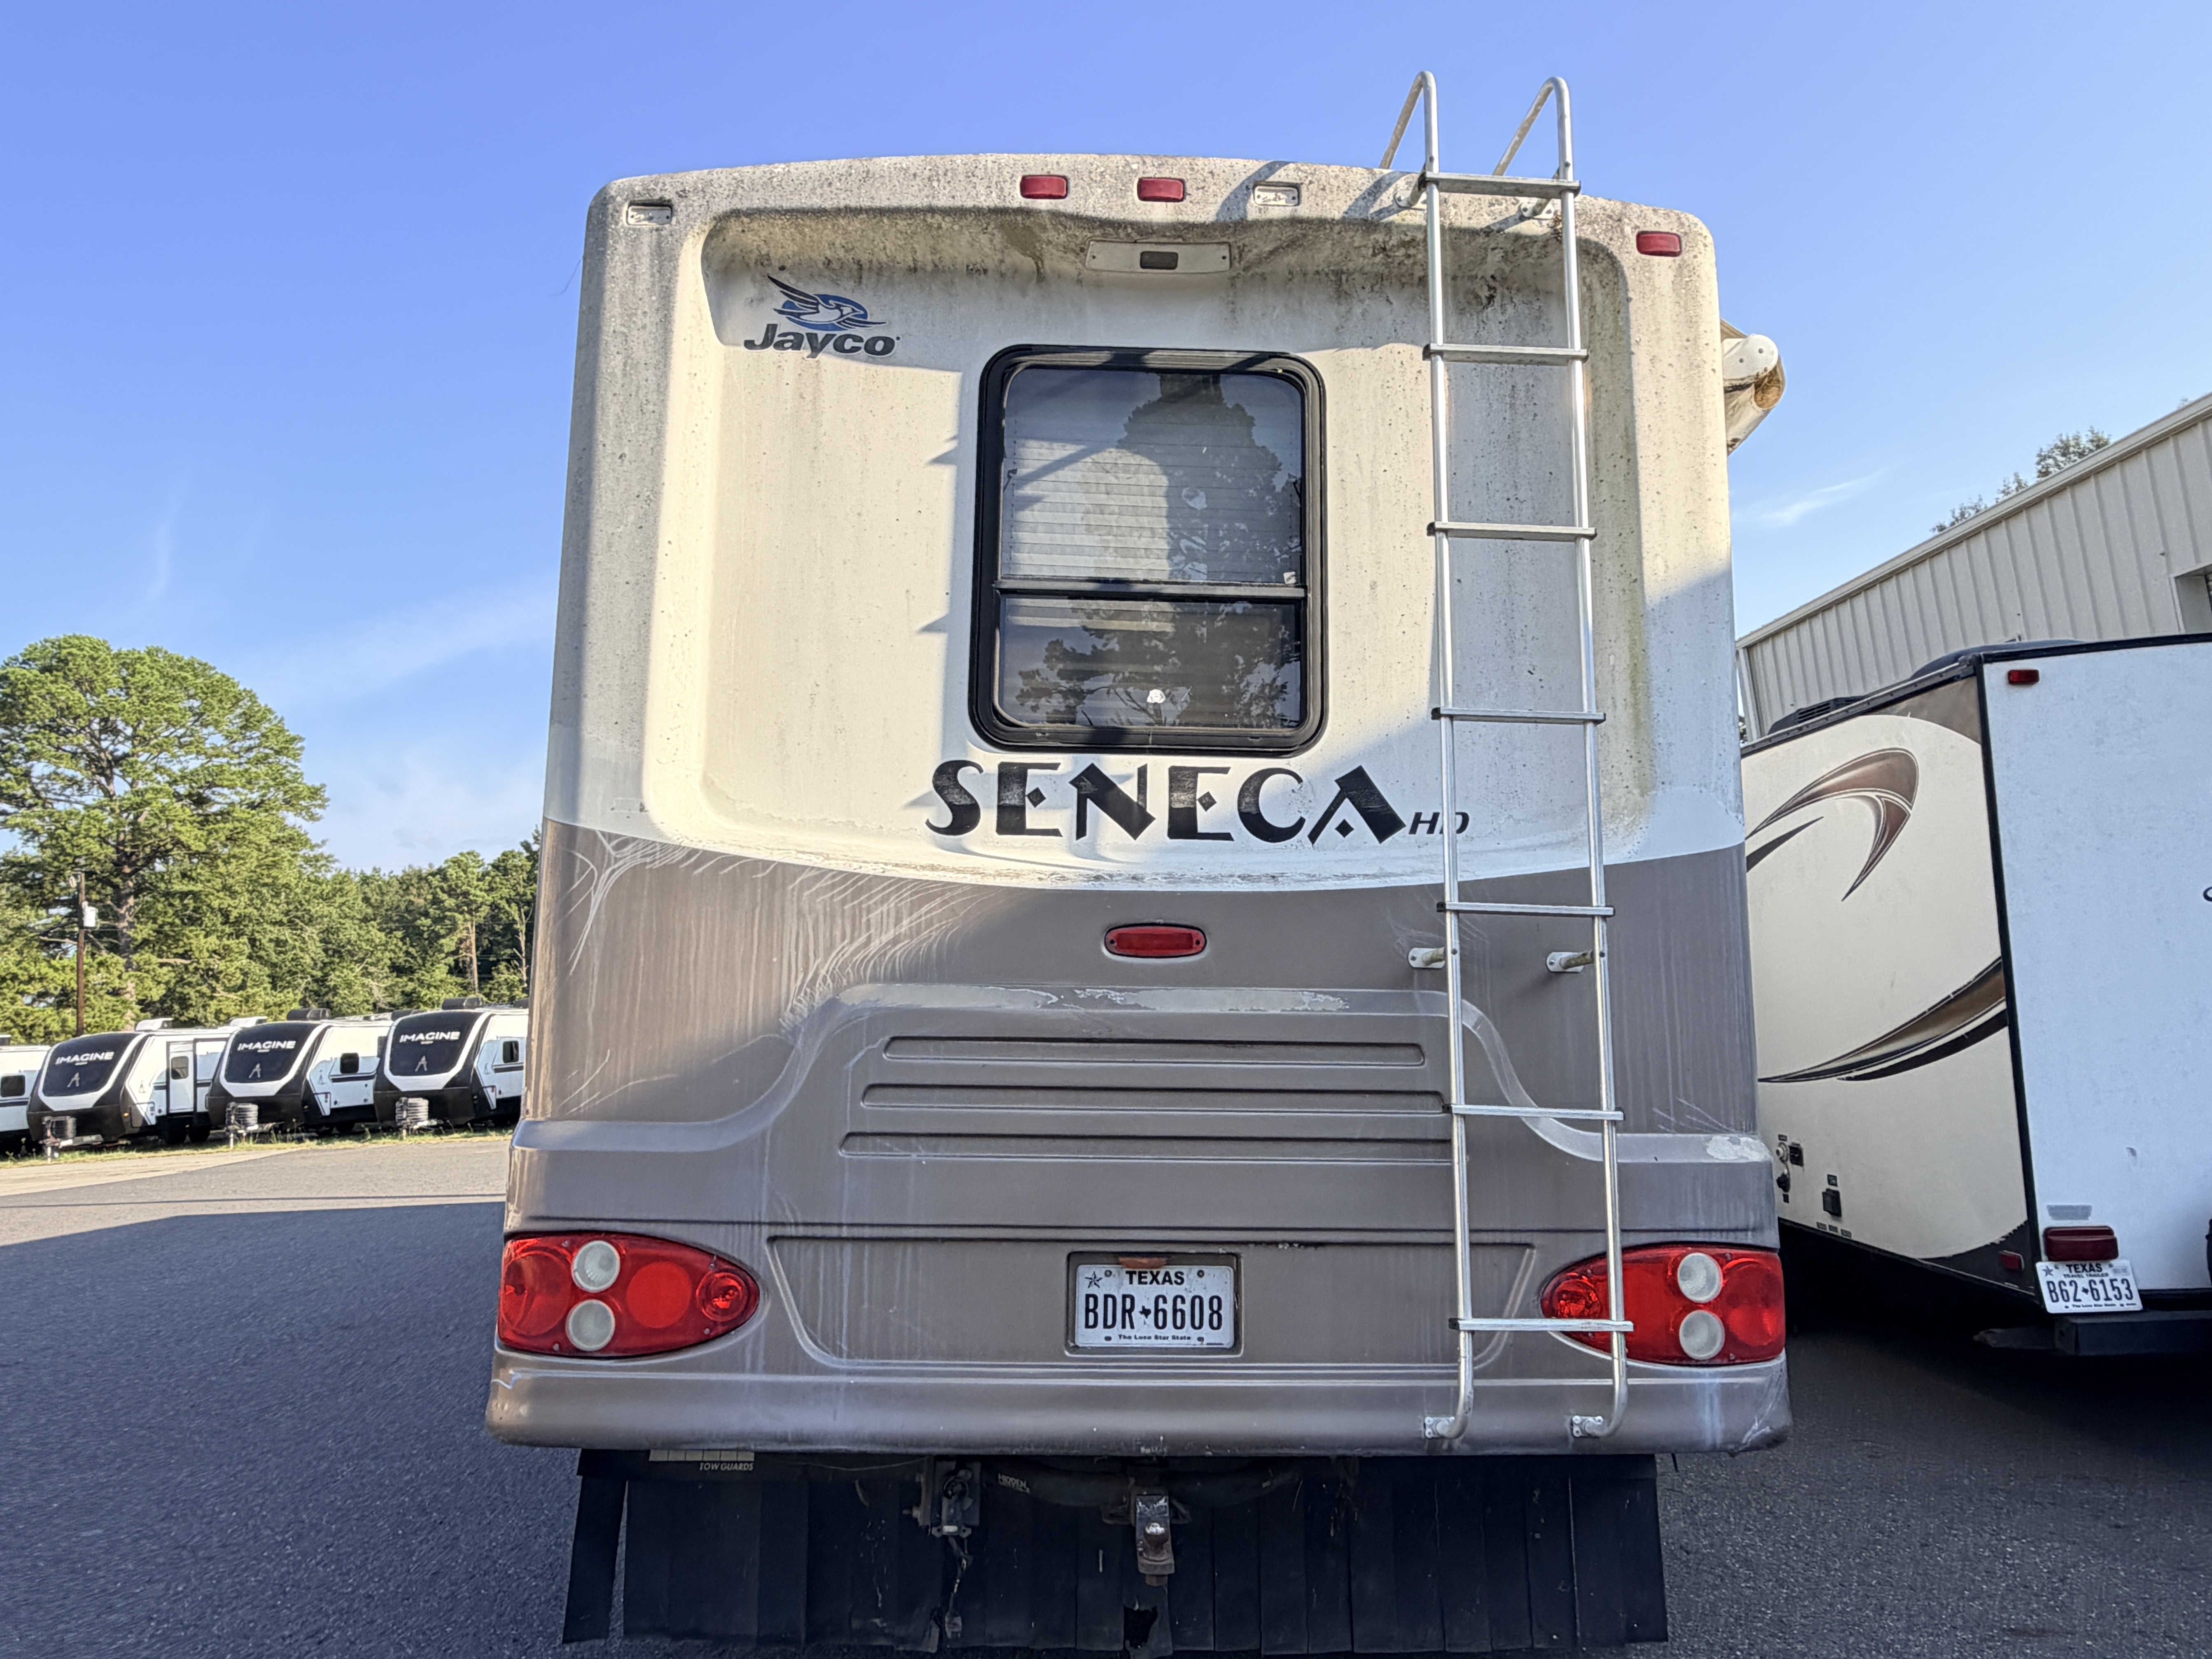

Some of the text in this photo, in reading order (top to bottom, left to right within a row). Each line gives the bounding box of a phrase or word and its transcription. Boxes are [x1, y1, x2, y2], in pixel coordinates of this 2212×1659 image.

[744, 324, 896, 358] Jayco
[925, 760, 1406, 845] SENECA
[399, 1031, 460, 1043] IMAGINE
[237, 1041, 296, 1051] IMAGINE
[55, 1051, 114, 1065] IMAGINE
[2065, 1263, 2103, 1273] TEXAS
[1126, 1270, 1185, 1285] TEXAS
[699, 1463, 753, 1471] TOW GUARDS
